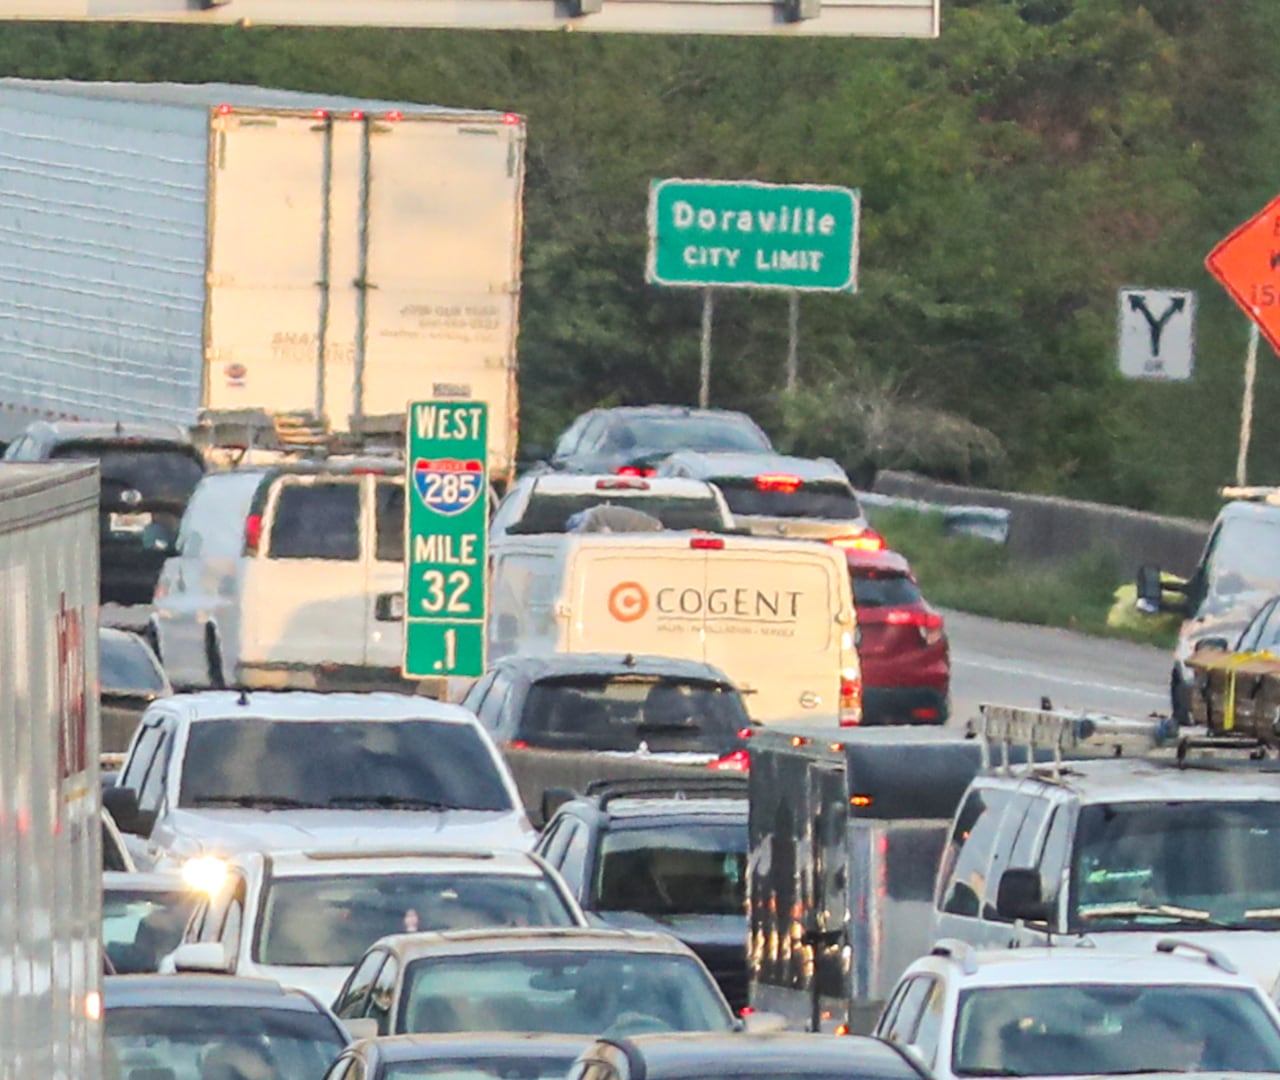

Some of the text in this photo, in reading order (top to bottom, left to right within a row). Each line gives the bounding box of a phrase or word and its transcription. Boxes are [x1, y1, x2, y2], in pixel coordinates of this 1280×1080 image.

[672, 200, 836, 235] Doraville
[683, 246, 824, 272] CITY LIMIT
[415, 404, 483, 440] WEST
[425, 473, 476, 504] 285
[414, 534, 478, 565] MILE
[421, 569, 471, 613] 32
[656, 587, 804, 617] COGENT
